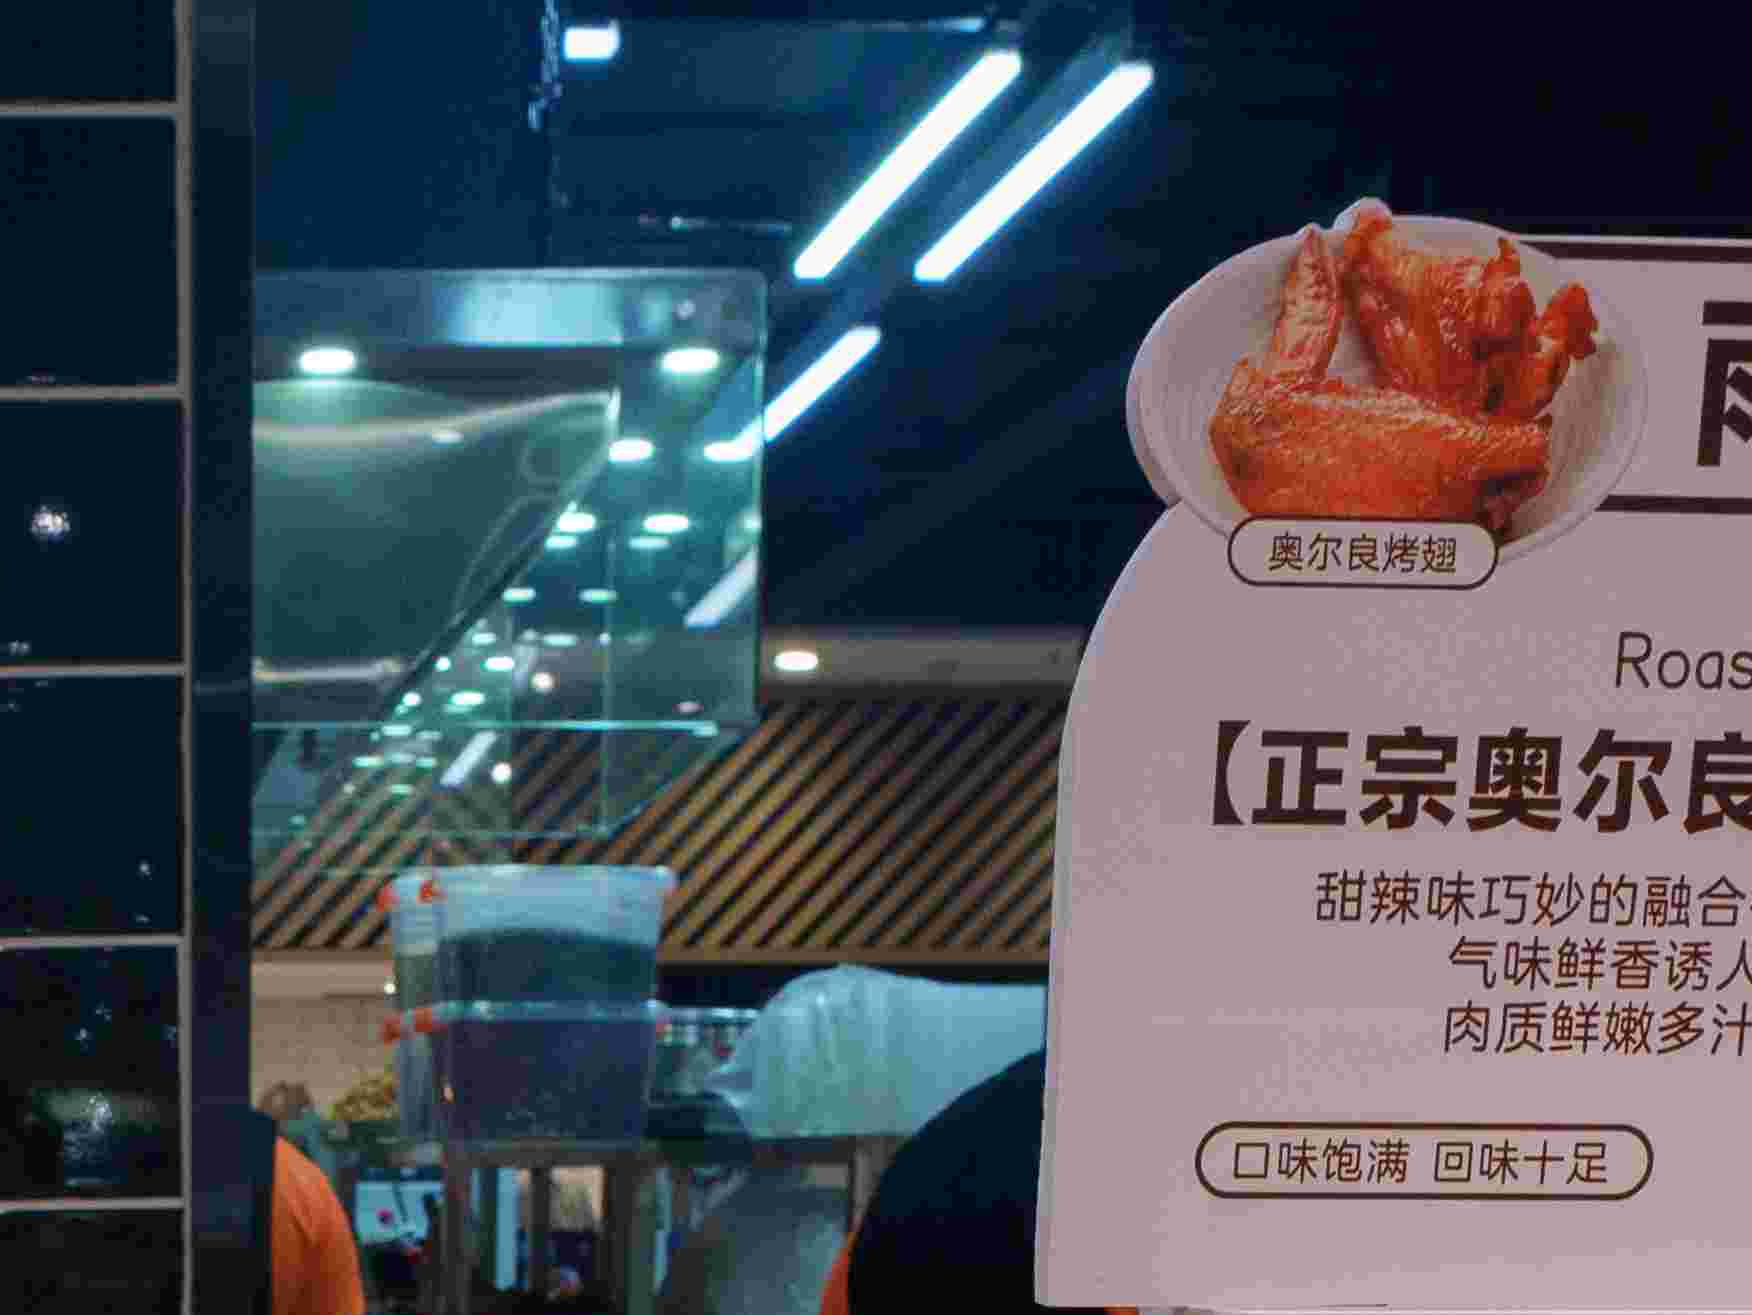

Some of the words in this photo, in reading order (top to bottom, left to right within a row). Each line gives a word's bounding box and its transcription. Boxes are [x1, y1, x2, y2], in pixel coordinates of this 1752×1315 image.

[1267, 532, 1458, 575] 奥尔良烤翅
[1233, 1138, 1410, 1185] 口味饱满
[1434, 1139, 1607, 1185] 回味十足
